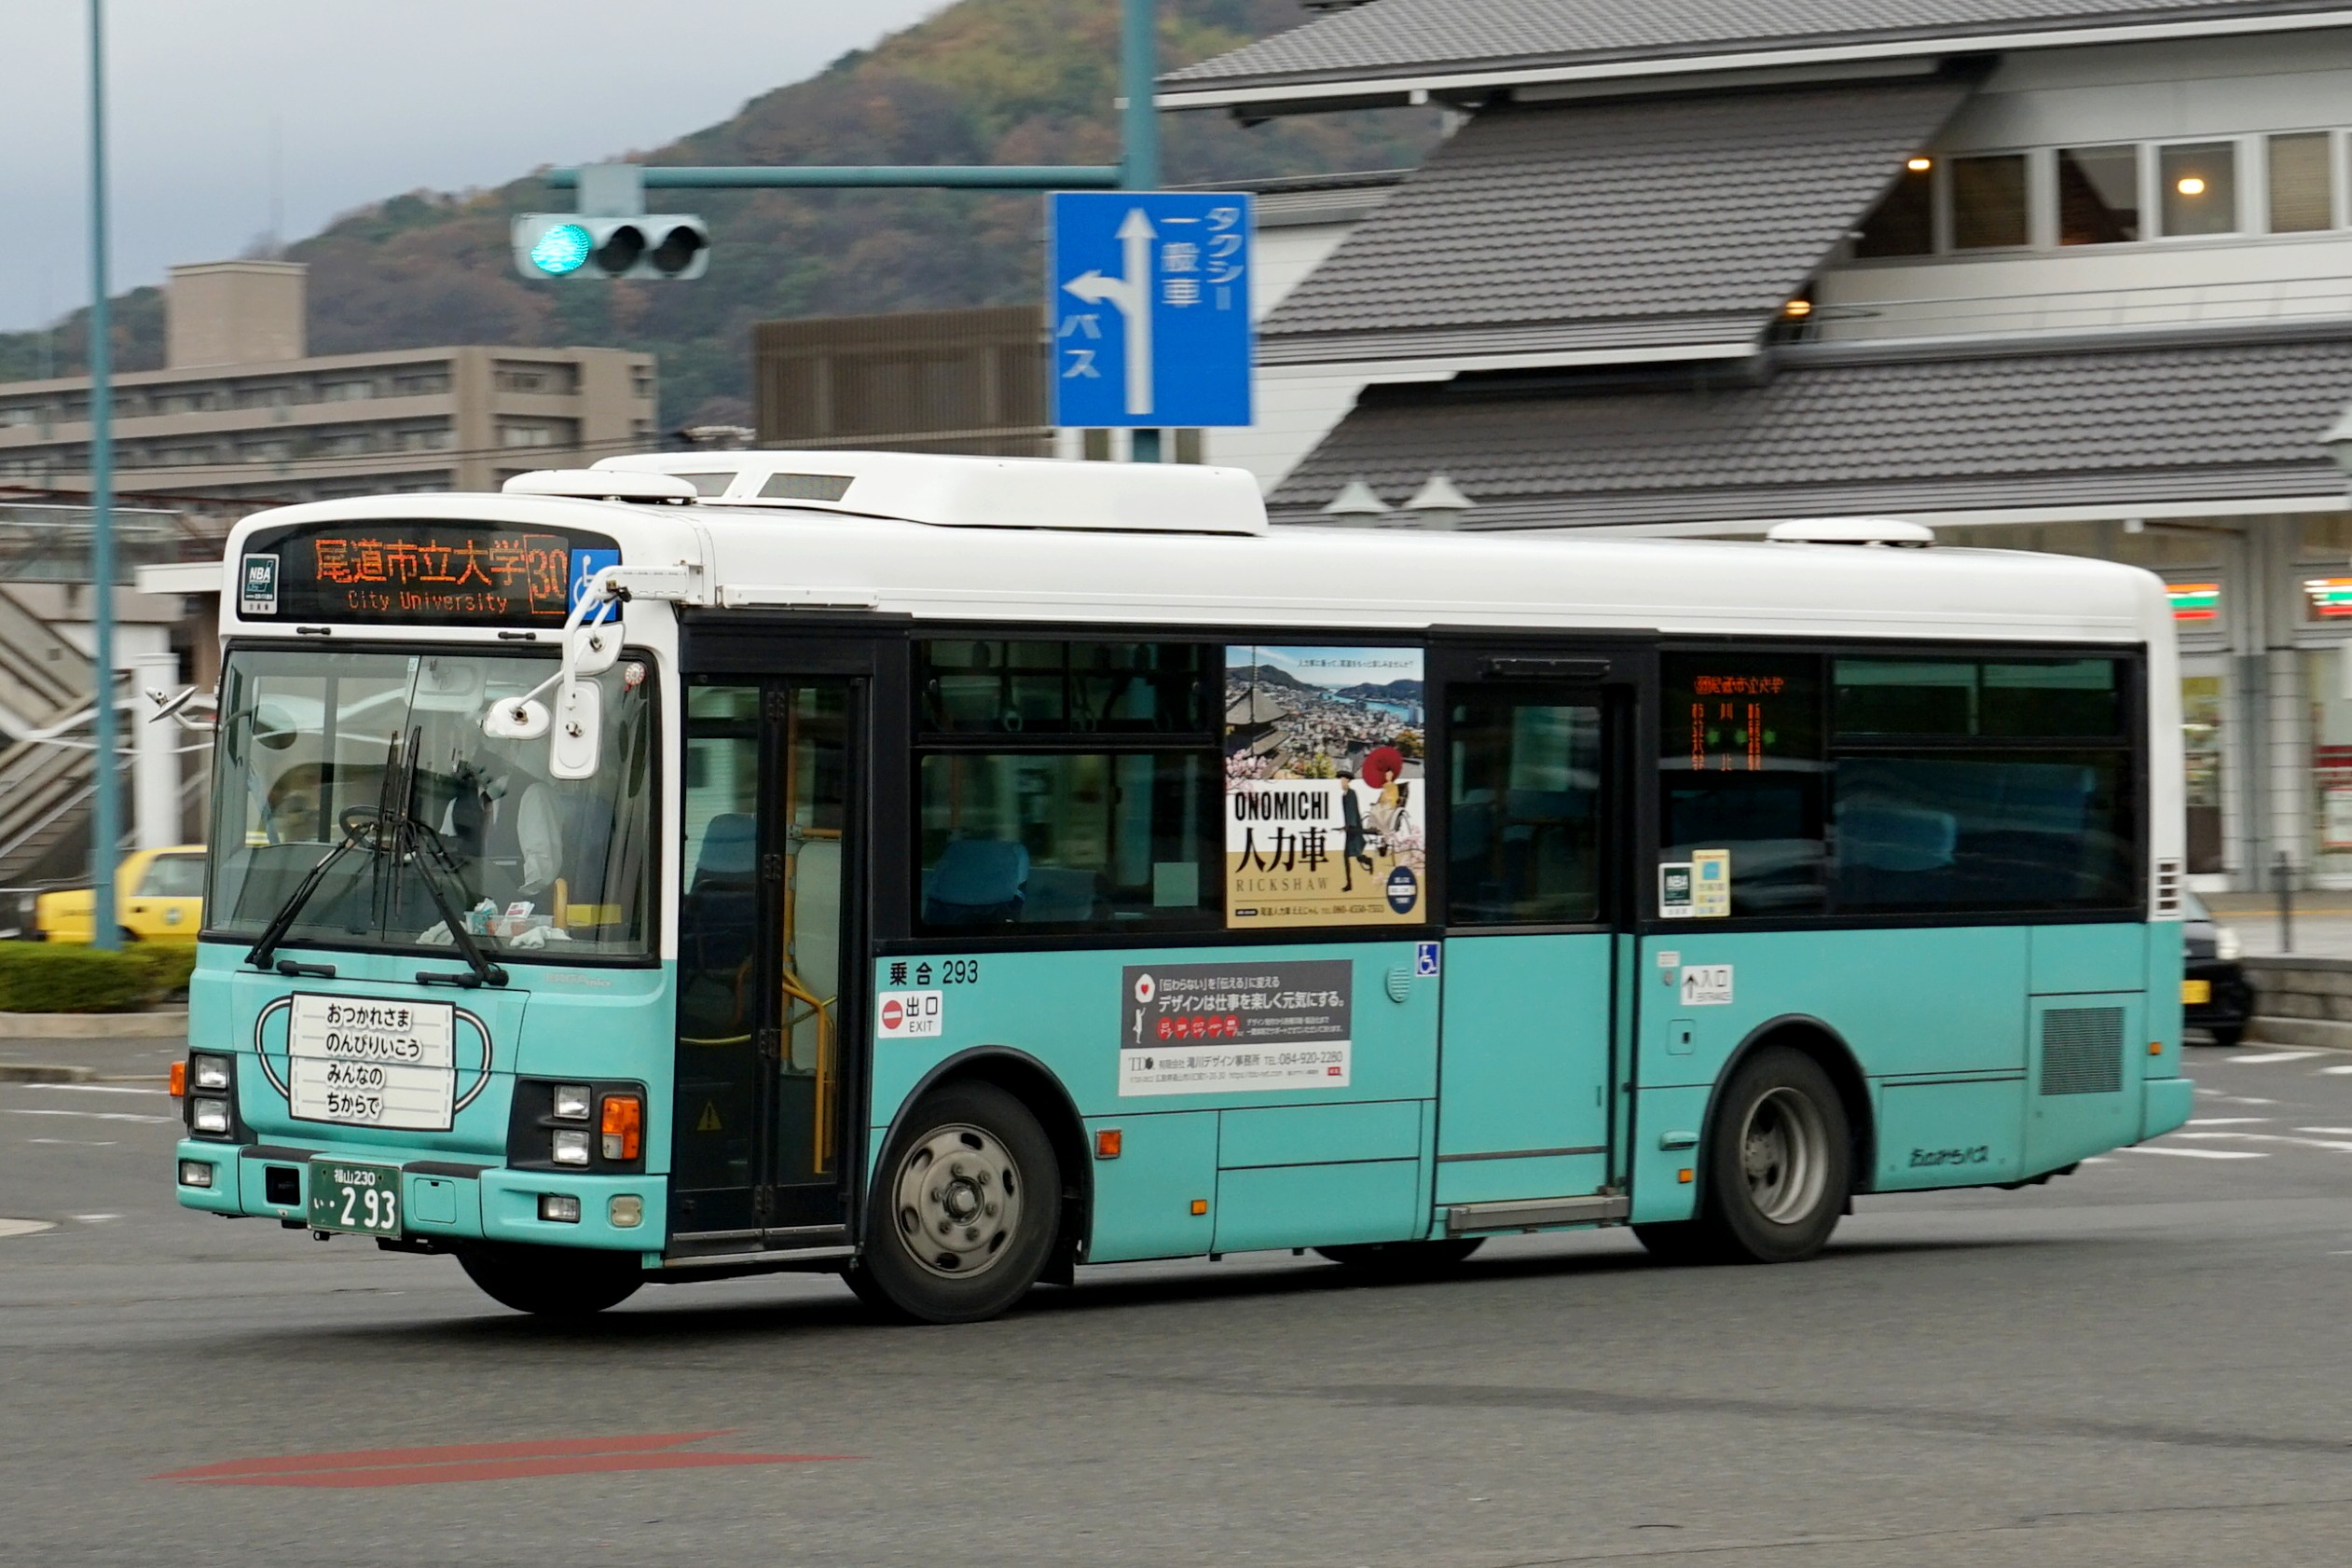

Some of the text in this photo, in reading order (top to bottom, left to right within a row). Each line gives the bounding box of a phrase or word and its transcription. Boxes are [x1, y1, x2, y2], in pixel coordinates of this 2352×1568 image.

[1204, 207, 1245, 310] タクシー
[1056, 313, 1102, 378] バス
[249, 567, 271, 581] NBA
[315, 539, 568, 598] 尾道市立大学 30
[347, 590, 508, 613] City University
[1234, 791, 1329, 821] ONOMICHI
[1235, 826, 1329, 873] 人力車
[1236, 877, 1329, 892] RICKSHAW
[889, 959, 979, 985] 乗合 293
[1700, 970, 1727, 988] 入口
[906, 996, 939, 1018] 出口
[1159, 990, 1344, 1013] デザインは仕事を楽しく元気にする。
[327, 1003, 409, 1027] おつかれさま
[909, 1020, 934, 1033] EXIT
[327, 1064, 382, 1086] みんなの
[327, 1092, 379, 1115] ちからで
